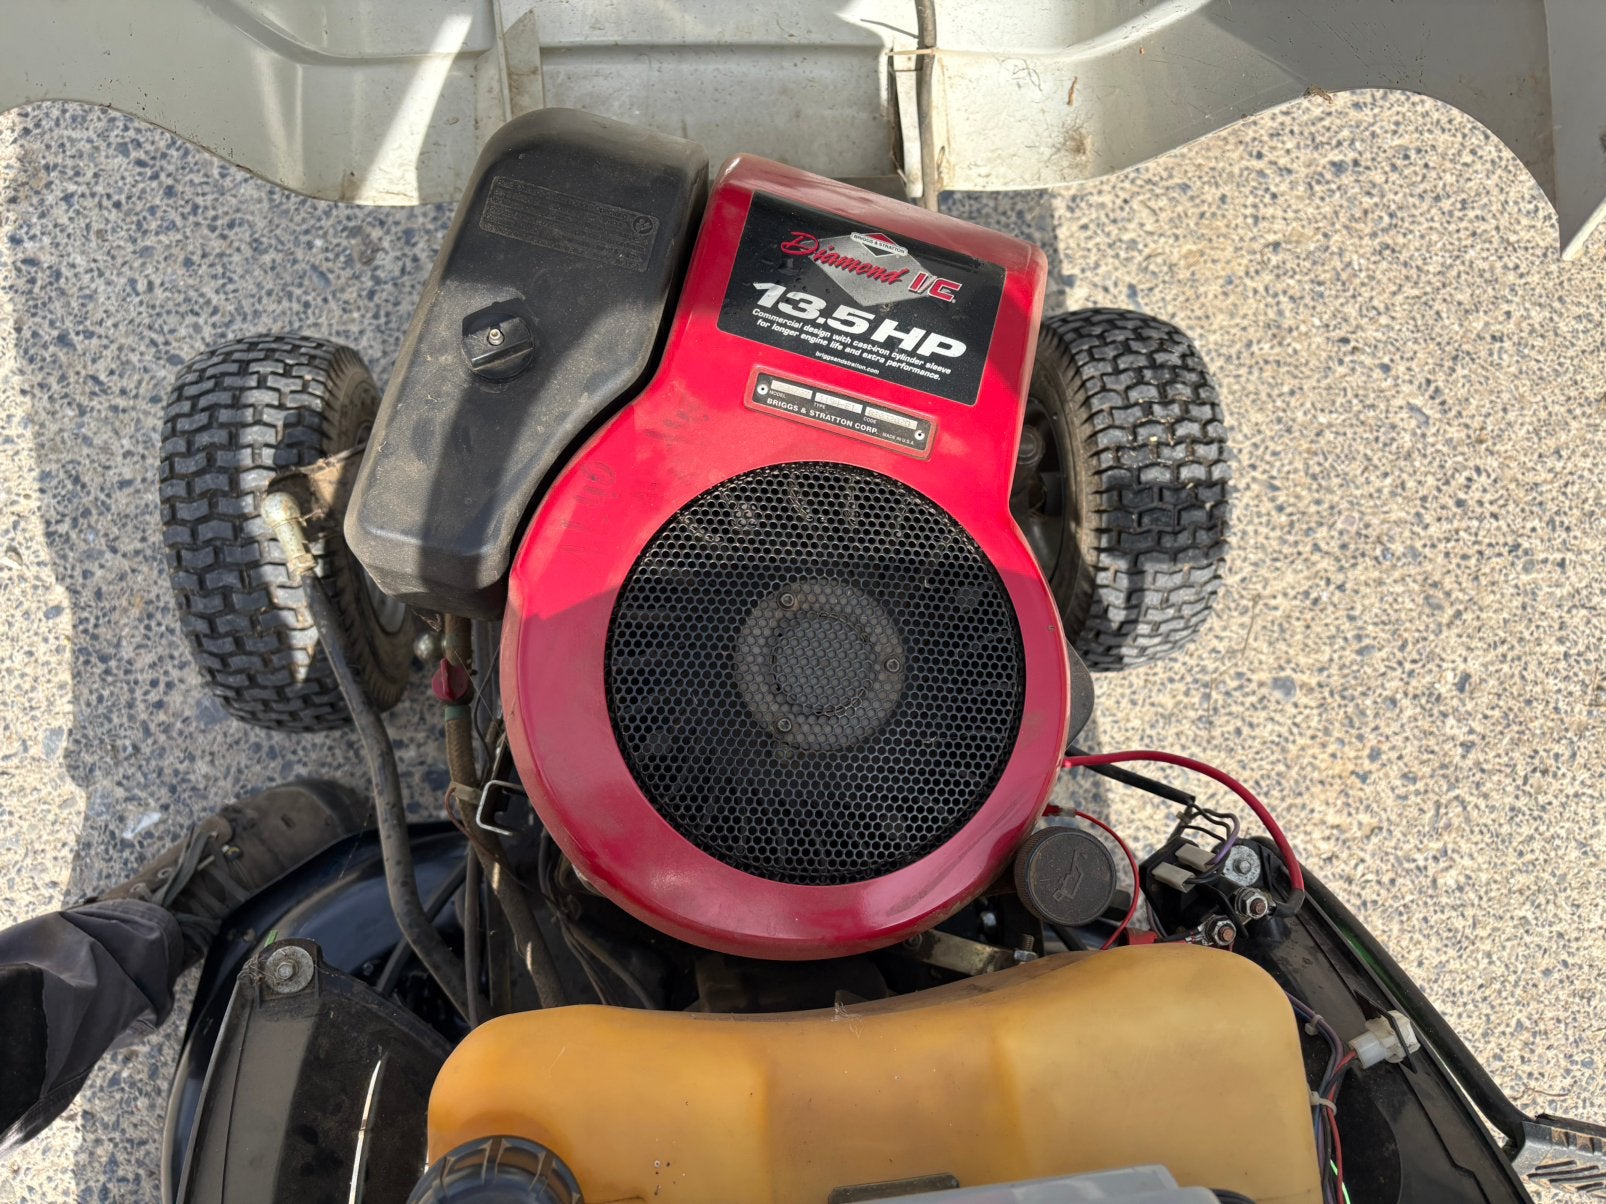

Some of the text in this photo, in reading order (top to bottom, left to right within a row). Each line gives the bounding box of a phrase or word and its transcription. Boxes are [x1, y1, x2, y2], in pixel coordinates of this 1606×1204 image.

[853, 234, 874, 244] BRIGGS
[781, 231, 910, 285] Diamond
[753, 282, 967, 358] 13.5 HP
[752, 308, 952, 375] Commercial design with cast-iron cylinder sleeve
[756, 318, 941, 381] for longer engine life and extra performance.
[769, 390, 786, 399] MODEL
[813, 402, 826, 410] TYPE
[766, 397, 799, 412] BRIGGS
[809, 409, 853, 427] STRATTON
[854, 422, 878, 435] CORP.
[863, 416, 877, 425] CODE
[882, 431, 896, 440] MADE
